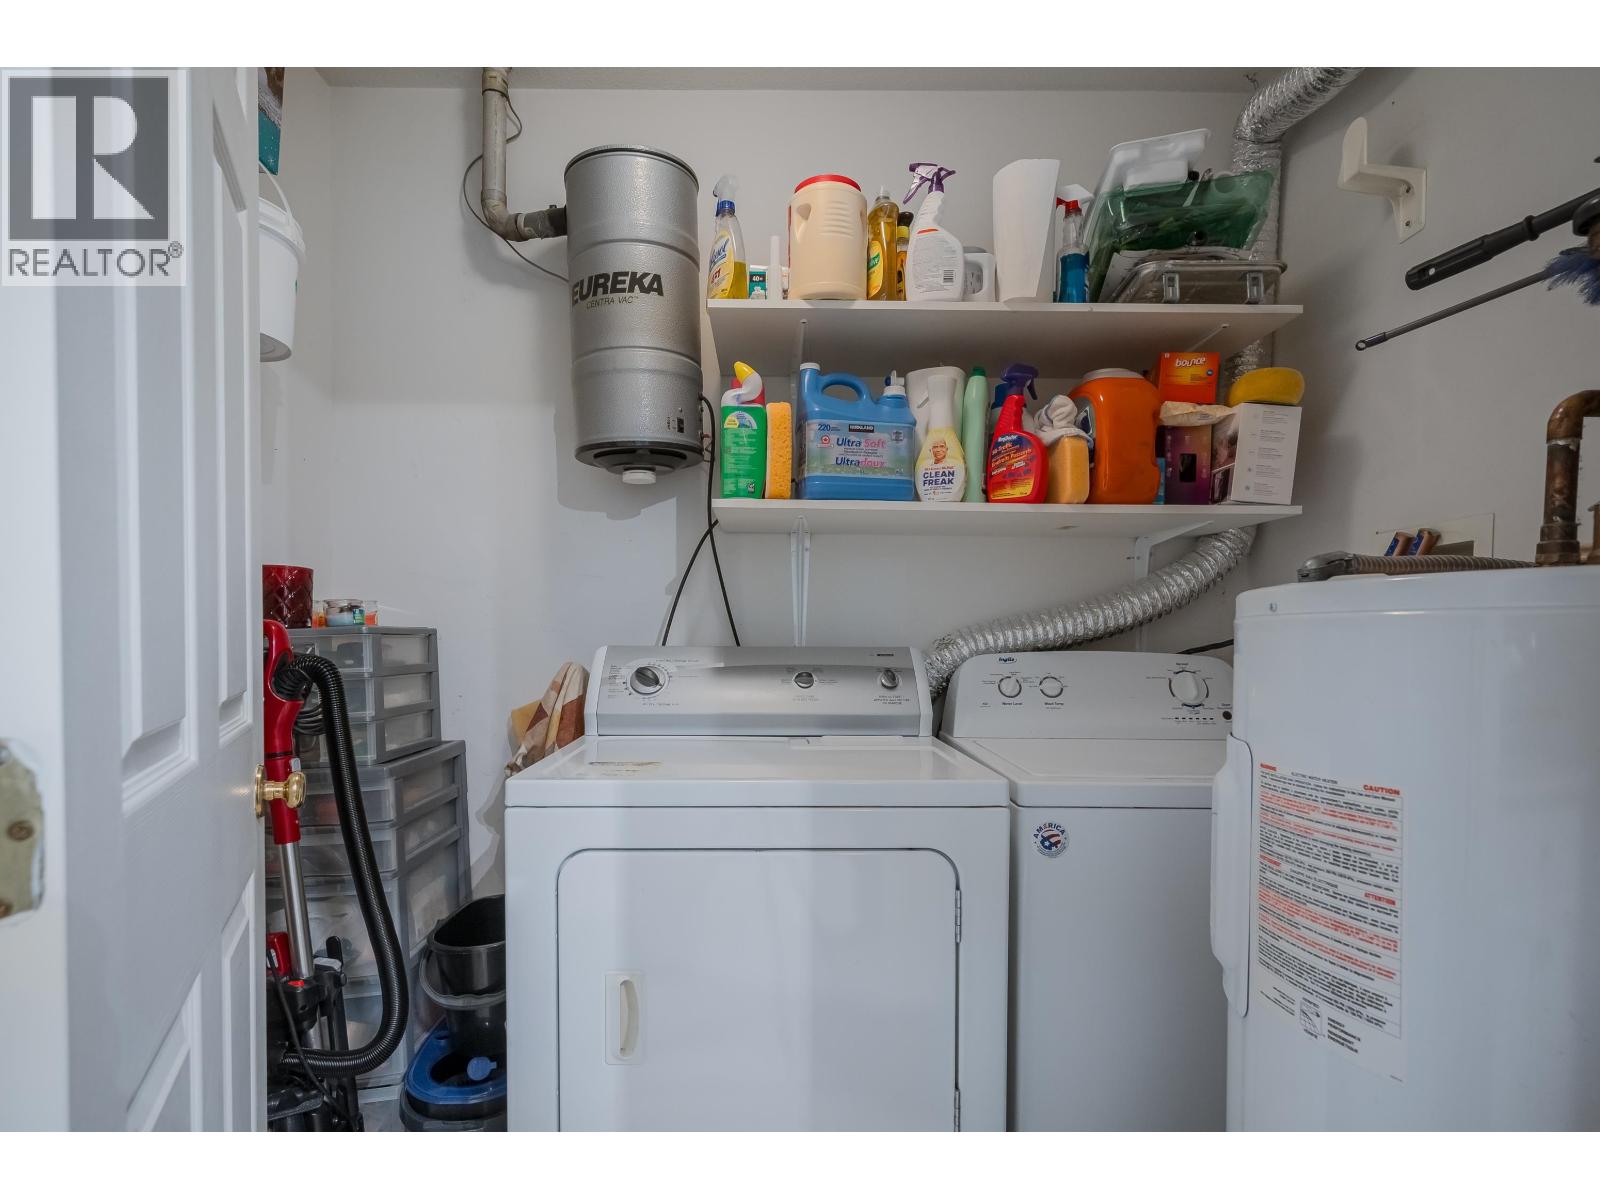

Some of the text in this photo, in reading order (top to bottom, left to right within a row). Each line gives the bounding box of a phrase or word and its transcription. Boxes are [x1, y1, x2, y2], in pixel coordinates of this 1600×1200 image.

[572, 271, 664, 306] EUREKA
[587, 296, 616, 309] CENTRA
[1176, 356, 1206, 367] bounce
[817, 423, 831, 432] 220
[836, 437, 887, 449] Ultra Soft
[835, 456, 886, 468] Ultradoux
[923, 470, 955, 480] CLEAN
[923, 477, 954, 487] FREAK
[1363, 784, 1400, 796] CAUTION
[1033, 822, 1066, 839] AMERICA
